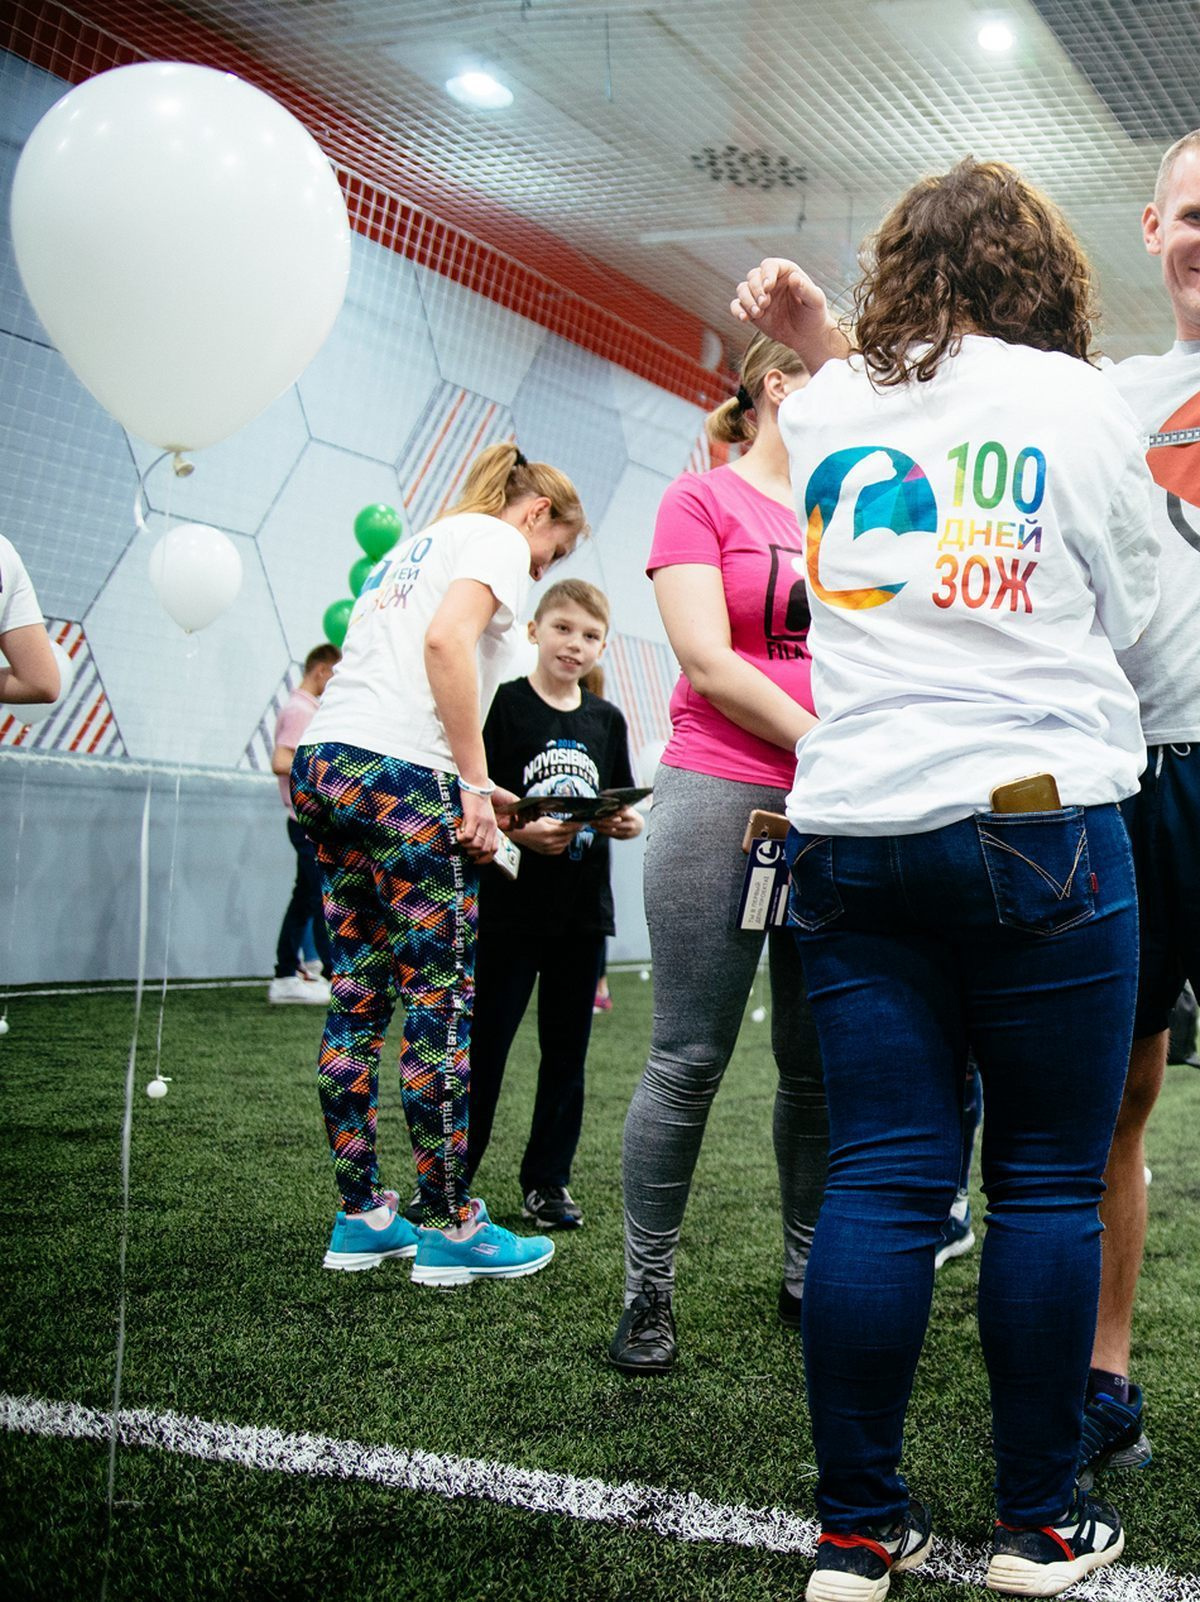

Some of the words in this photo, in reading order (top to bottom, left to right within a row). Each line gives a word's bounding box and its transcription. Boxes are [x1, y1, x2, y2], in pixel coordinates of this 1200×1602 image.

[947, 441, 1047, 514] 100
[937, 518, 1043, 553] ДНЕЙ
[932, 554, 1038, 614] ЗОЖ
[766, 640, 805, 660] FILA
